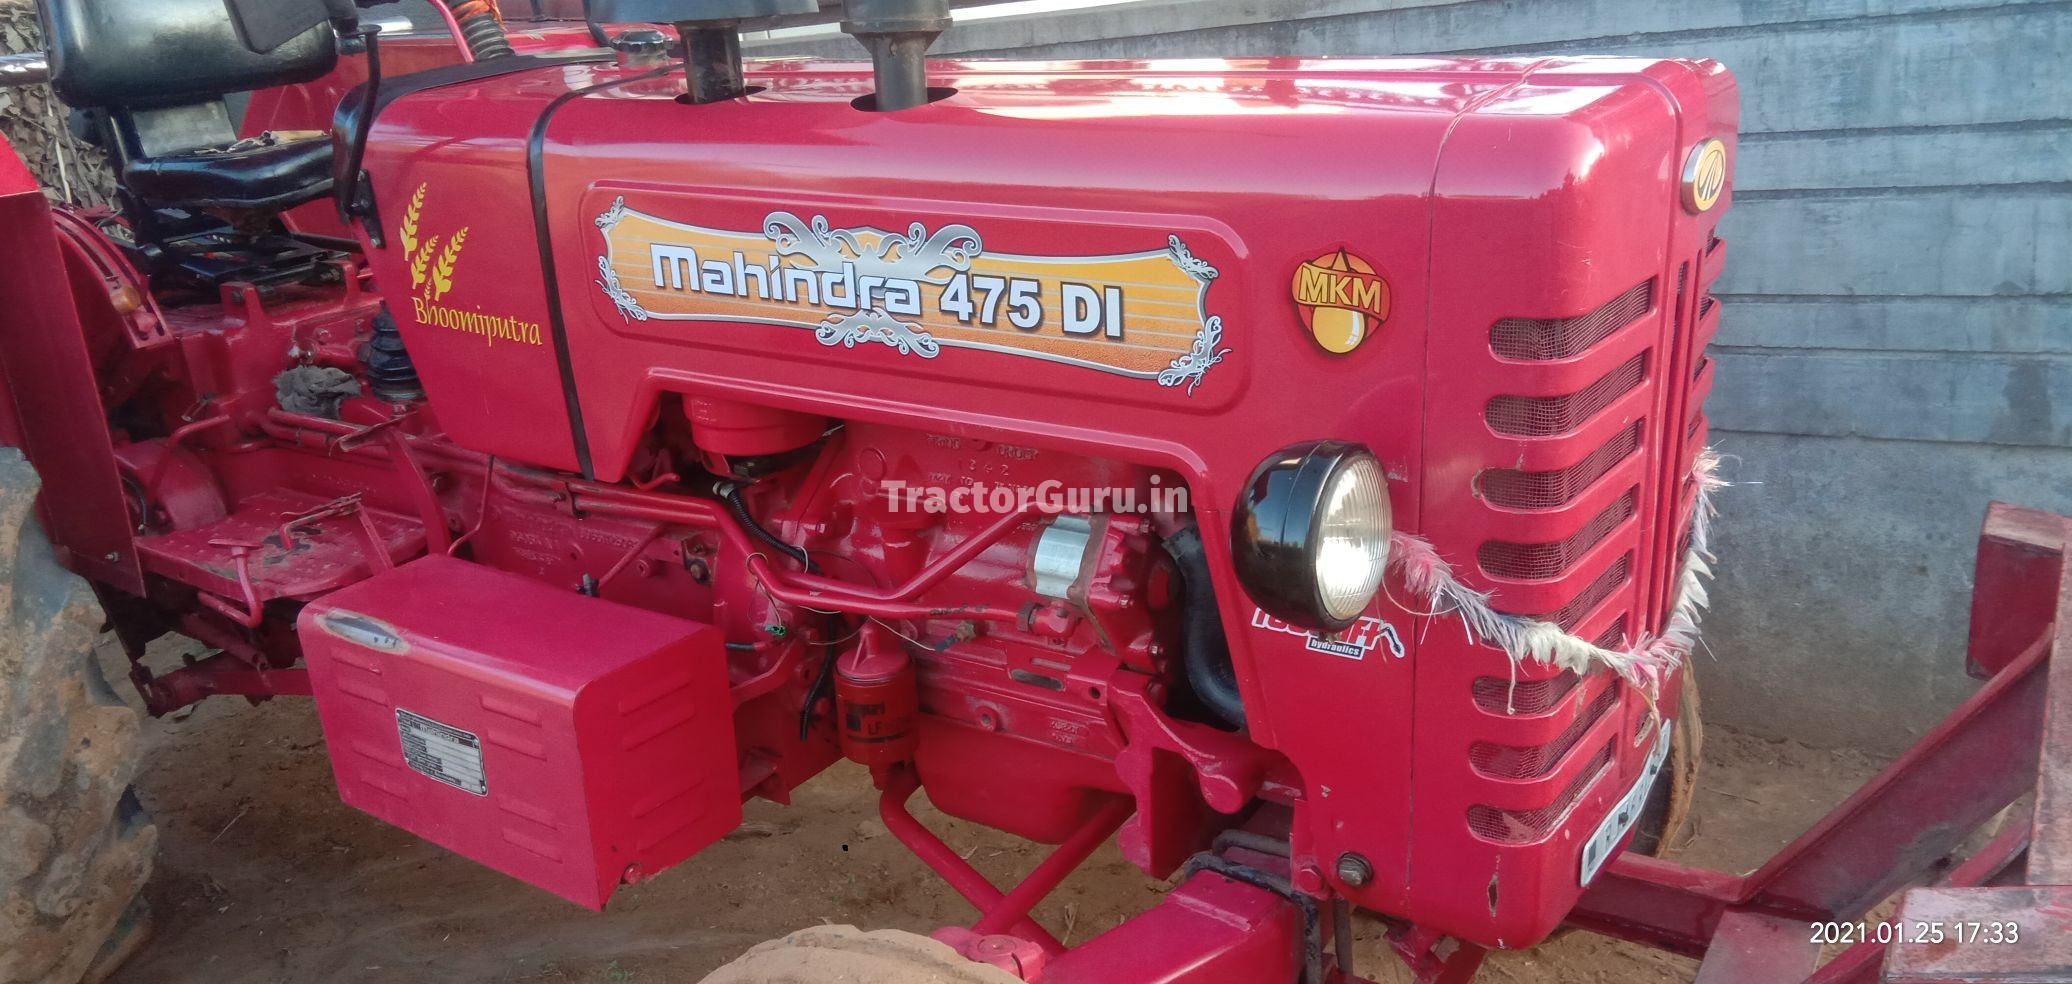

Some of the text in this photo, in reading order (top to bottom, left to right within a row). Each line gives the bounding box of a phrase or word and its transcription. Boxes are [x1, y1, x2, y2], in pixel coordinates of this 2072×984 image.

[650, 243, 1122, 338] Mahindra 475 DI
[1298, 264, 1382, 315] MKM
[411, 296, 543, 347] Bhoomiputra
[1311, 639, 1360, 656] hydraulics
